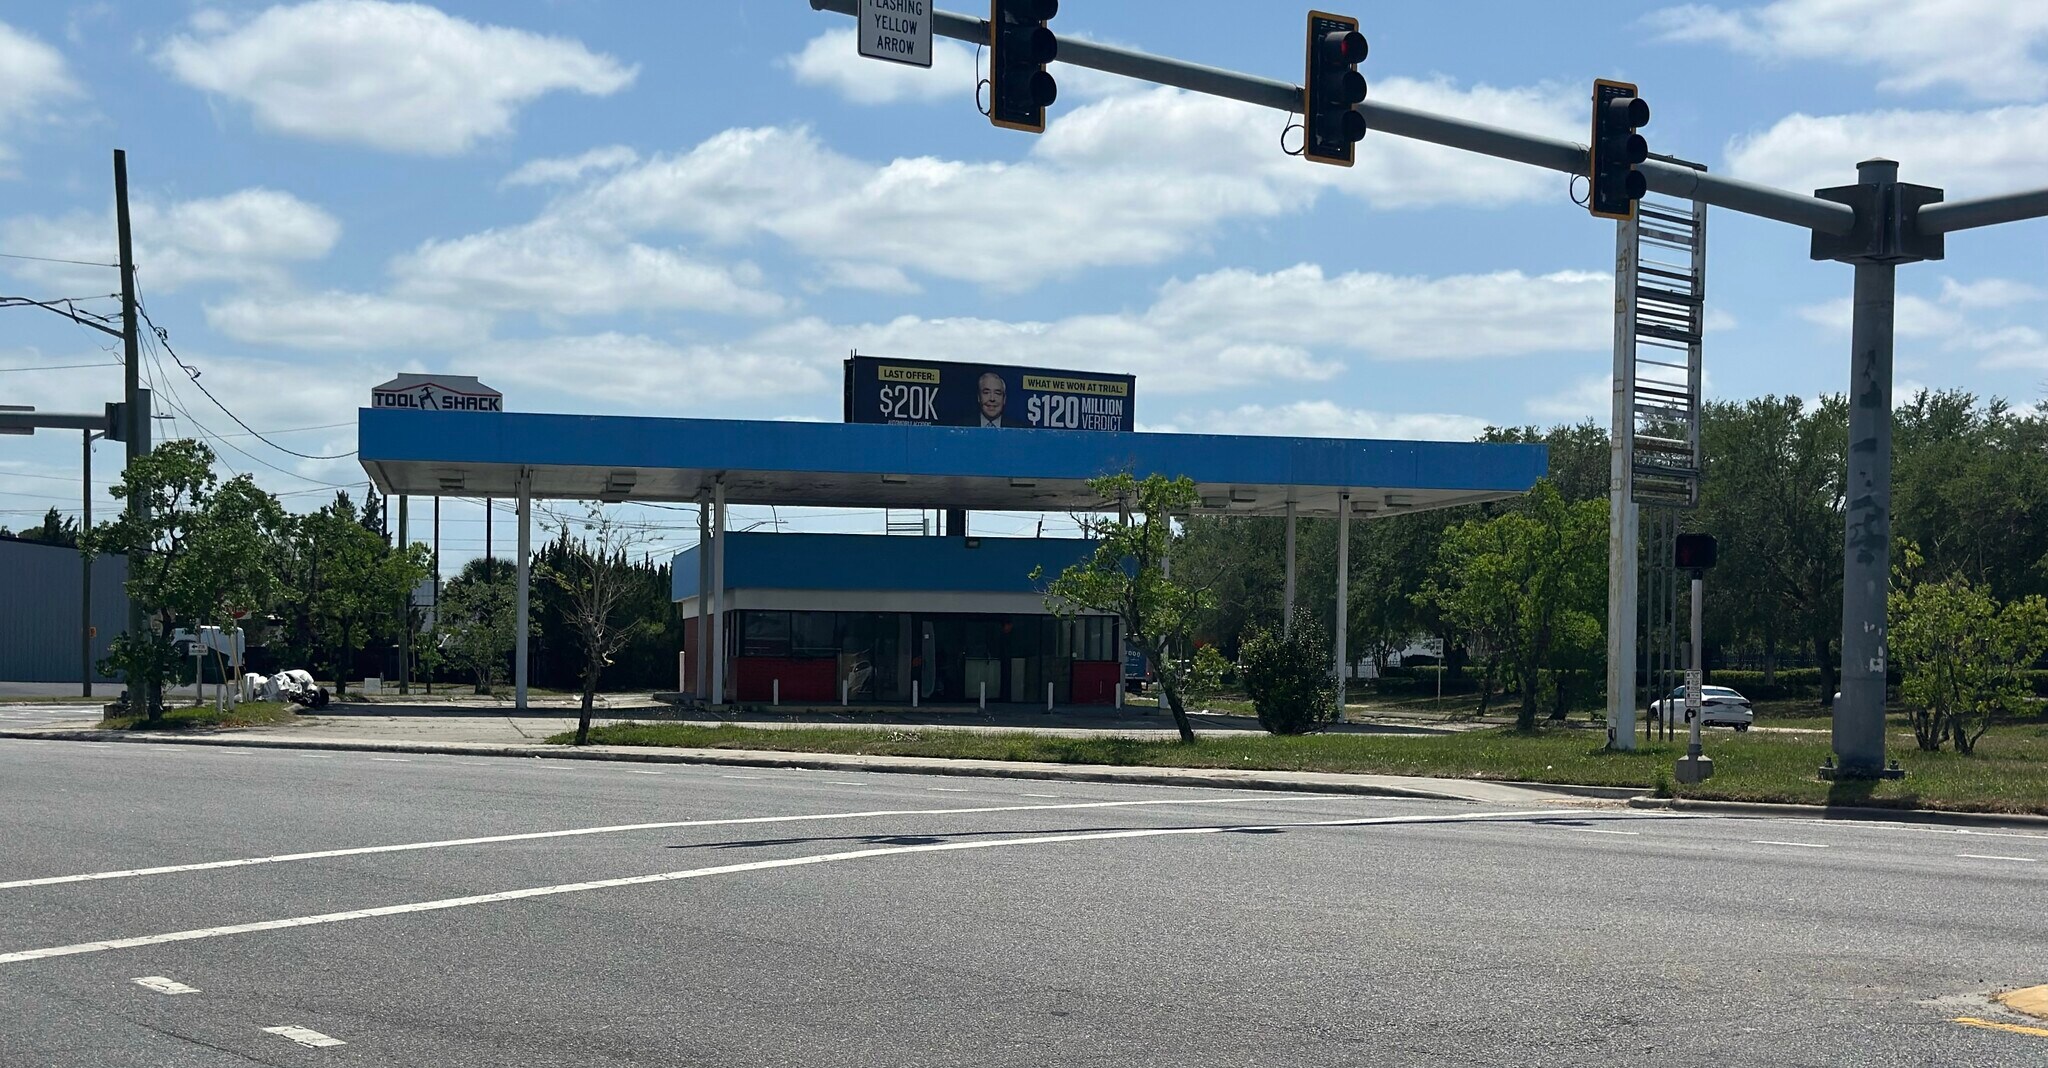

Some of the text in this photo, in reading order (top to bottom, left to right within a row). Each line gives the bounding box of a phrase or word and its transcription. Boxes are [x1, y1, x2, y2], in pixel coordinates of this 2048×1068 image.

[874, 14, 917, 35] YELLOW
[876, 35, 914, 55] ARROW
[884, 369, 935, 381] LAST OFFER:
[1028, 379, 1123, 393] WHAT WE WON AT TRIAL:
[374, 393, 500, 411] TOOL SHACK
[880, 384, 939, 420] $20K
[1027, 394, 1123, 428] $120 MILLION
[1082, 414, 1122, 431] VERDICT
